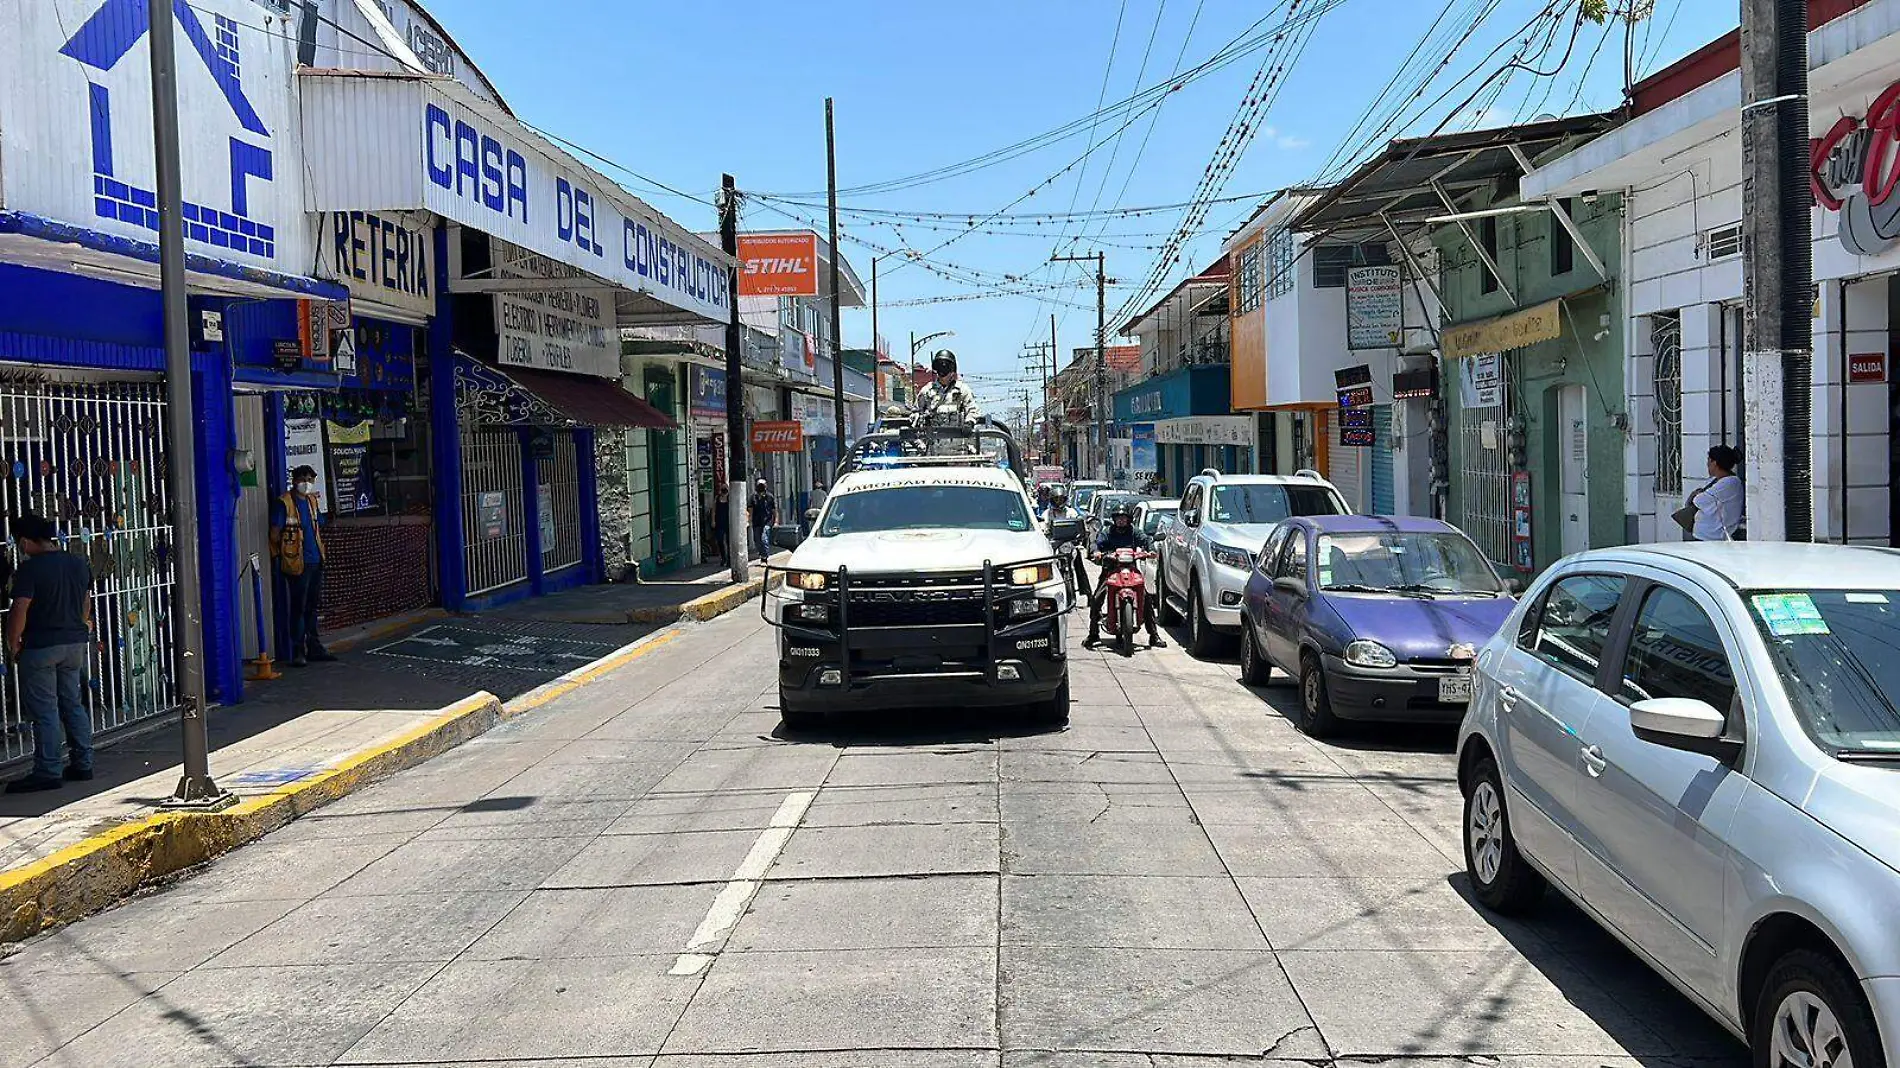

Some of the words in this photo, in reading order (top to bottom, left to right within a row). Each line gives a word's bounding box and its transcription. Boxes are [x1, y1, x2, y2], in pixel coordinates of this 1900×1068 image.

[426, 102, 527, 224] CASA
[556, 176, 603, 257] DEL
[623, 216, 729, 309] CONSTRUCTOR
[333, 211, 429, 298] RETERIA
[744, 257, 808, 274] STIHL
[1350, 268, 1399, 281] INSTITUTO
[1852, 362, 1882, 373] SALIDA
[754, 430, 797, 442] STIHL
